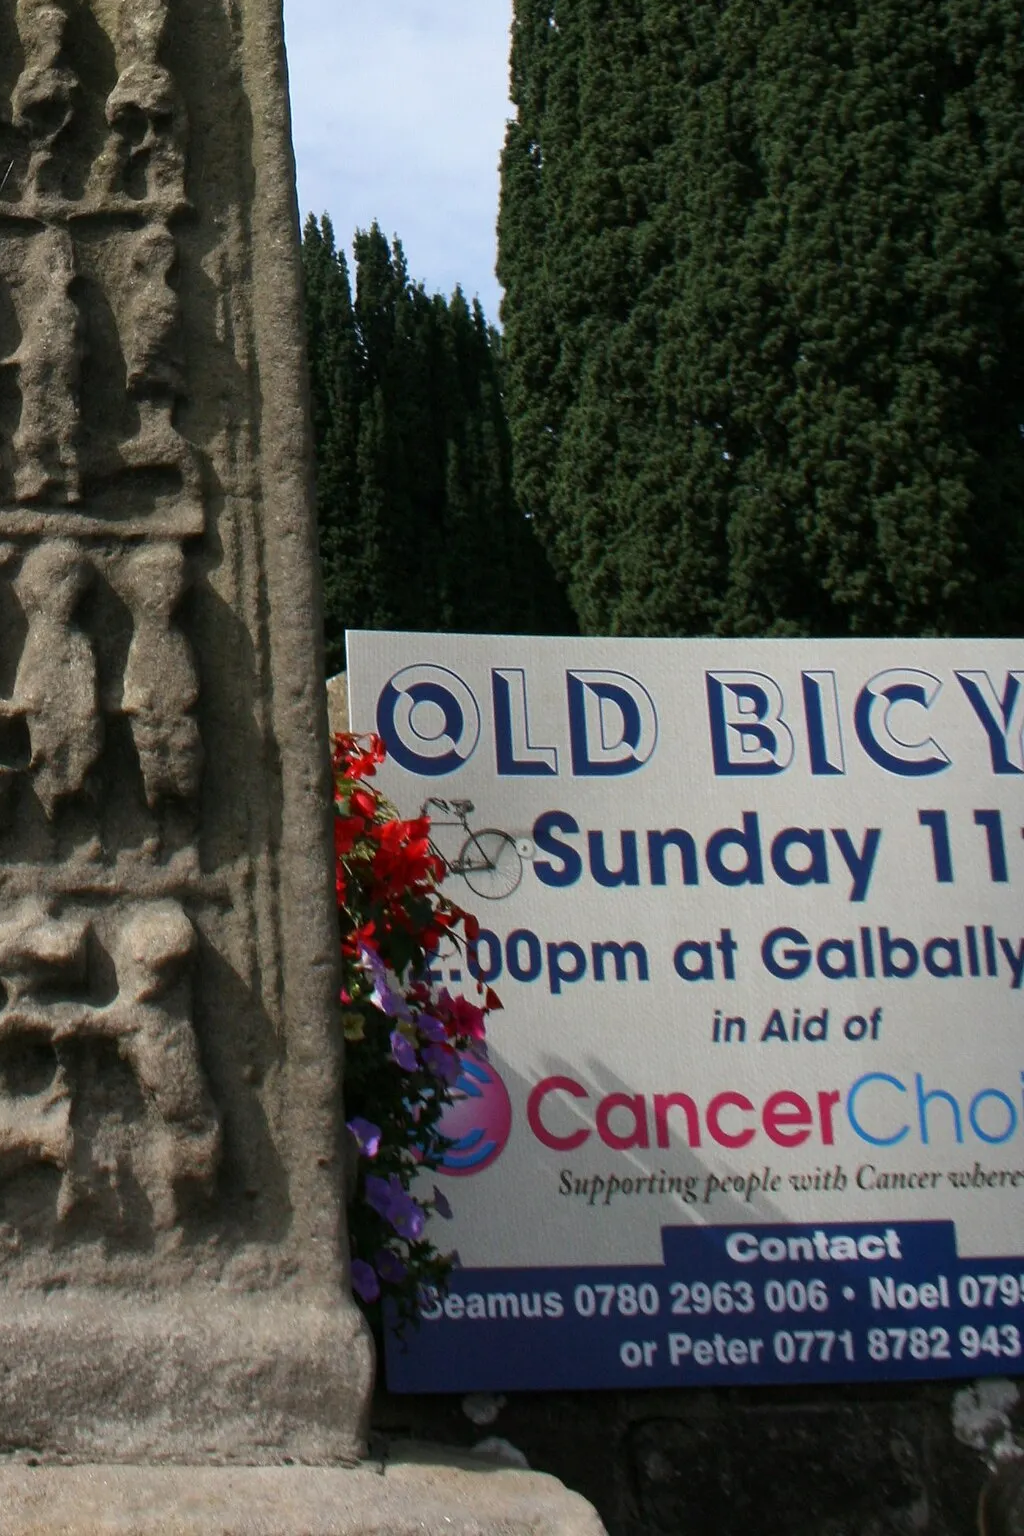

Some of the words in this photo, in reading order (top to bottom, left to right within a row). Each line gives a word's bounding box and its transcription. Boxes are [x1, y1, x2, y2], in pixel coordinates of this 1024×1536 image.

[376, 663, 658, 776] OLD
[532, 809, 881, 902] Sunday
[675, 928, 738, 981] at
[761, 925, 1024, 989] Galbally
[712, 1009, 746, 1043] in
[760, 1007, 828, 1043] Aid
[844, 1007, 882, 1041] of
[527, 1071, 1024, 1151] CancerCho
[559, 1168, 698, 1205] Supporting
[702, 1166, 781, 1203] people
[788, 1165, 847, 1192] with
[856, 1164, 942, 1191] Cancer
[726, 1229, 902, 1262] Contact
[575, 1282, 660, 1316] 0780
[669, 1279, 755, 1314] 2963
[764, 1278, 829, 1313] 006
[869, 1275, 950, 1310] Noel
[958, 1273, 1024, 1308] 079
[620, 1340, 657, 1368] or
[668, 1333, 764, 1366] Peter
[773, 1329, 854, 1364] 0771
[867, 1326, 951, 1361] 8782
[959, 1324, 1022, 1359] 943
